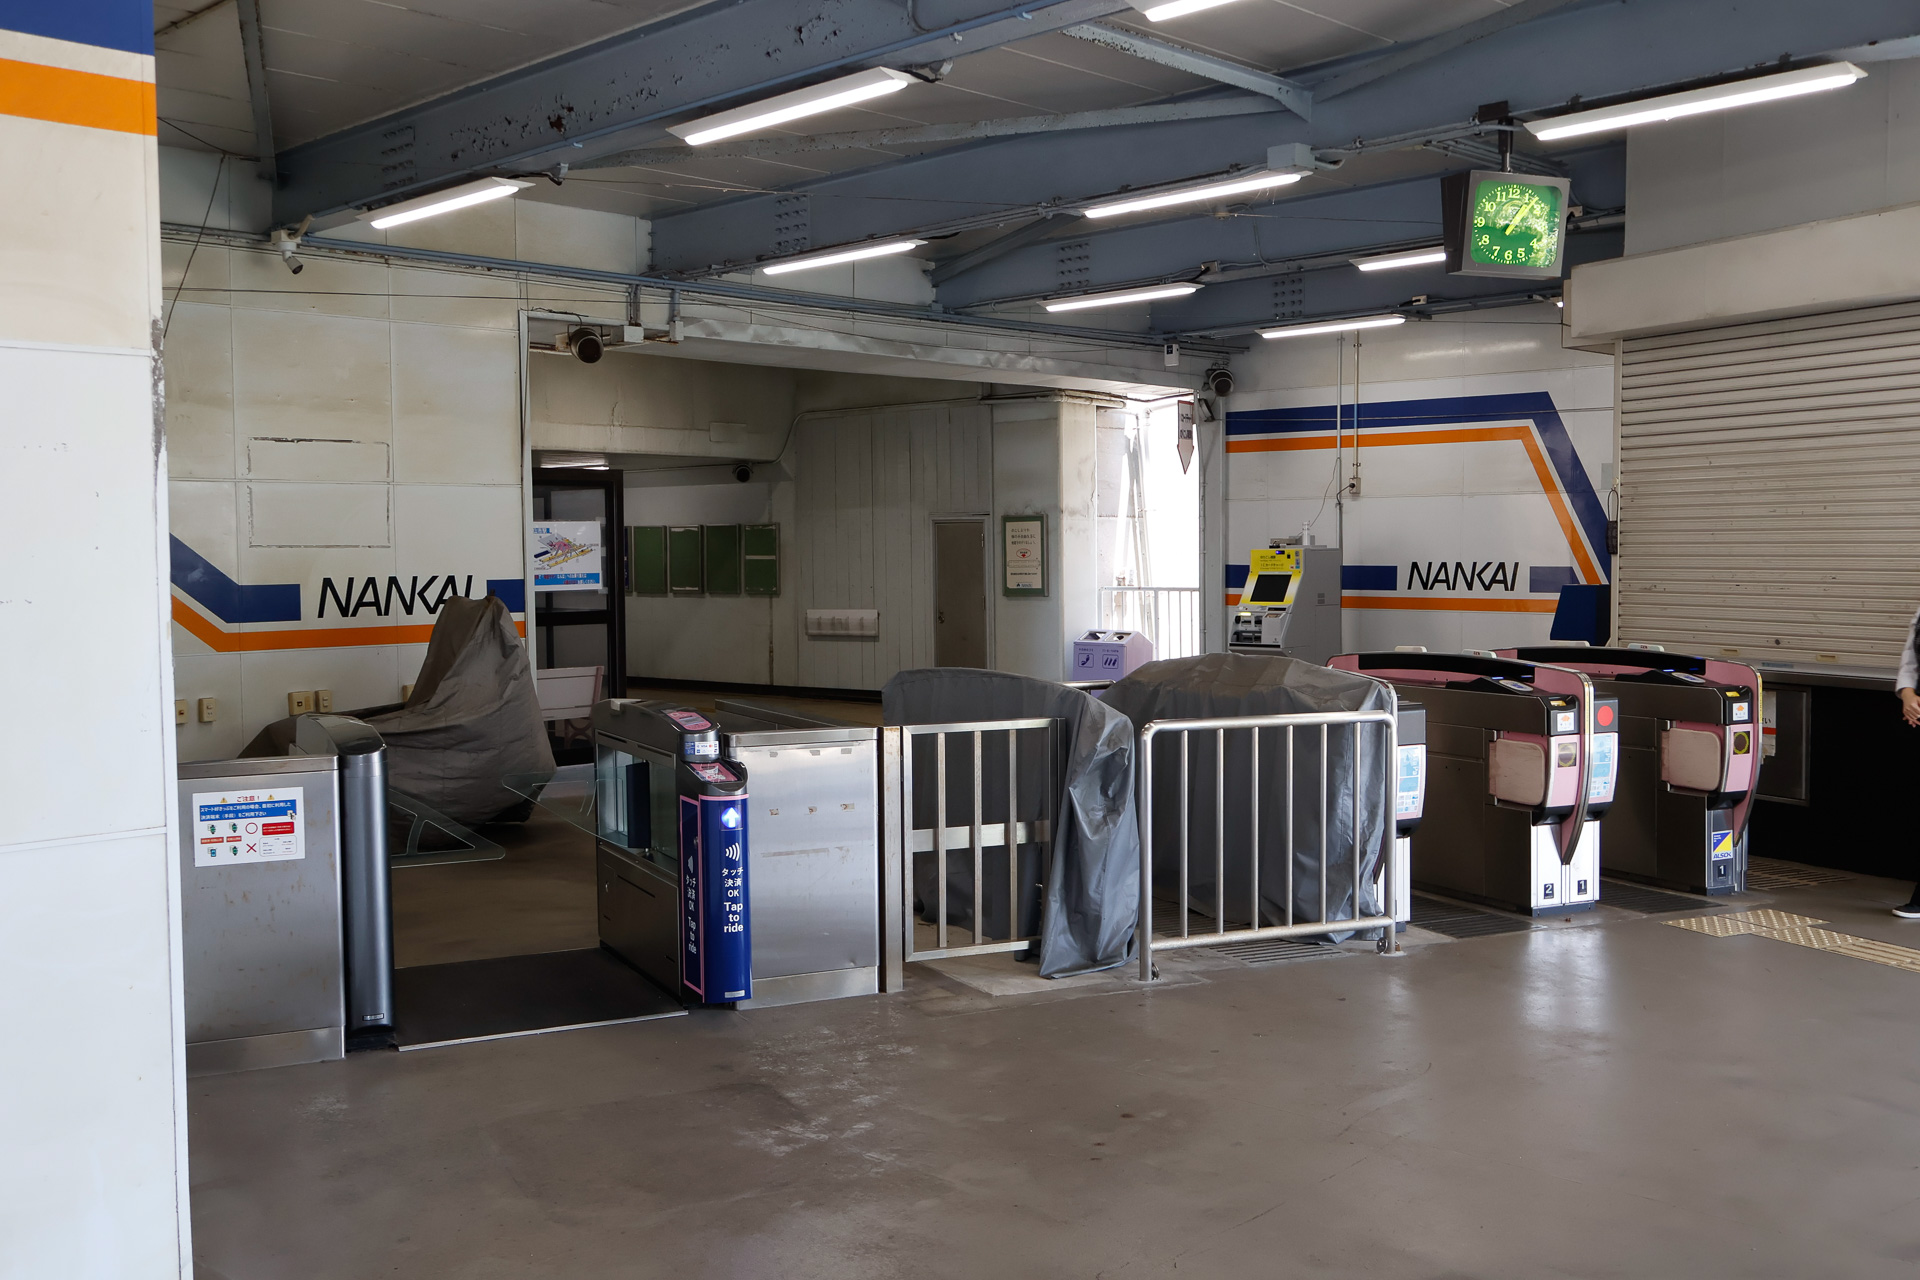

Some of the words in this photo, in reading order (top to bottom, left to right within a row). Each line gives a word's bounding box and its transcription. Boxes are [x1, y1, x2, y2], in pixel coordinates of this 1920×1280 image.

[1496, 192, 1506, 202] 11
[1508, 188, 1520, 198] 12
[1524, 193, 1530, 202] 1
[1484, 202, 1496, 212] 10
[1534, 204, 1541, 214] 2
[1476, 216, 1485, 227] 9
[1481, 234, 1490, 244] 8
[1530, 238, 1538, 248] 4
[1492, 246, 1500, 256] 7
[1504, 250, 1512, 260] 6
[1517, 248, 1525, 258] 5
[1407, 562, 1520, 592] NANKAI
[722, 866, 744, 876] タッチ
[1720, 865, 1724, 875] 1
[724, 878, 742, 887] 決済
[1580, 880, 1585, 890] 1
[728, 889, 740, 898] OK
[1545, 884, 1552, 894] 2
[688, 900, 695, 912] OK
[724, 902, 743, 913] Tap
[728, 913, 740, 922] to
[688, 916, 696, 931] Tap
[724, 923, 744, 933] ride
[690, 931, 695, 941] to
[688, 941, 697, 954] ride
